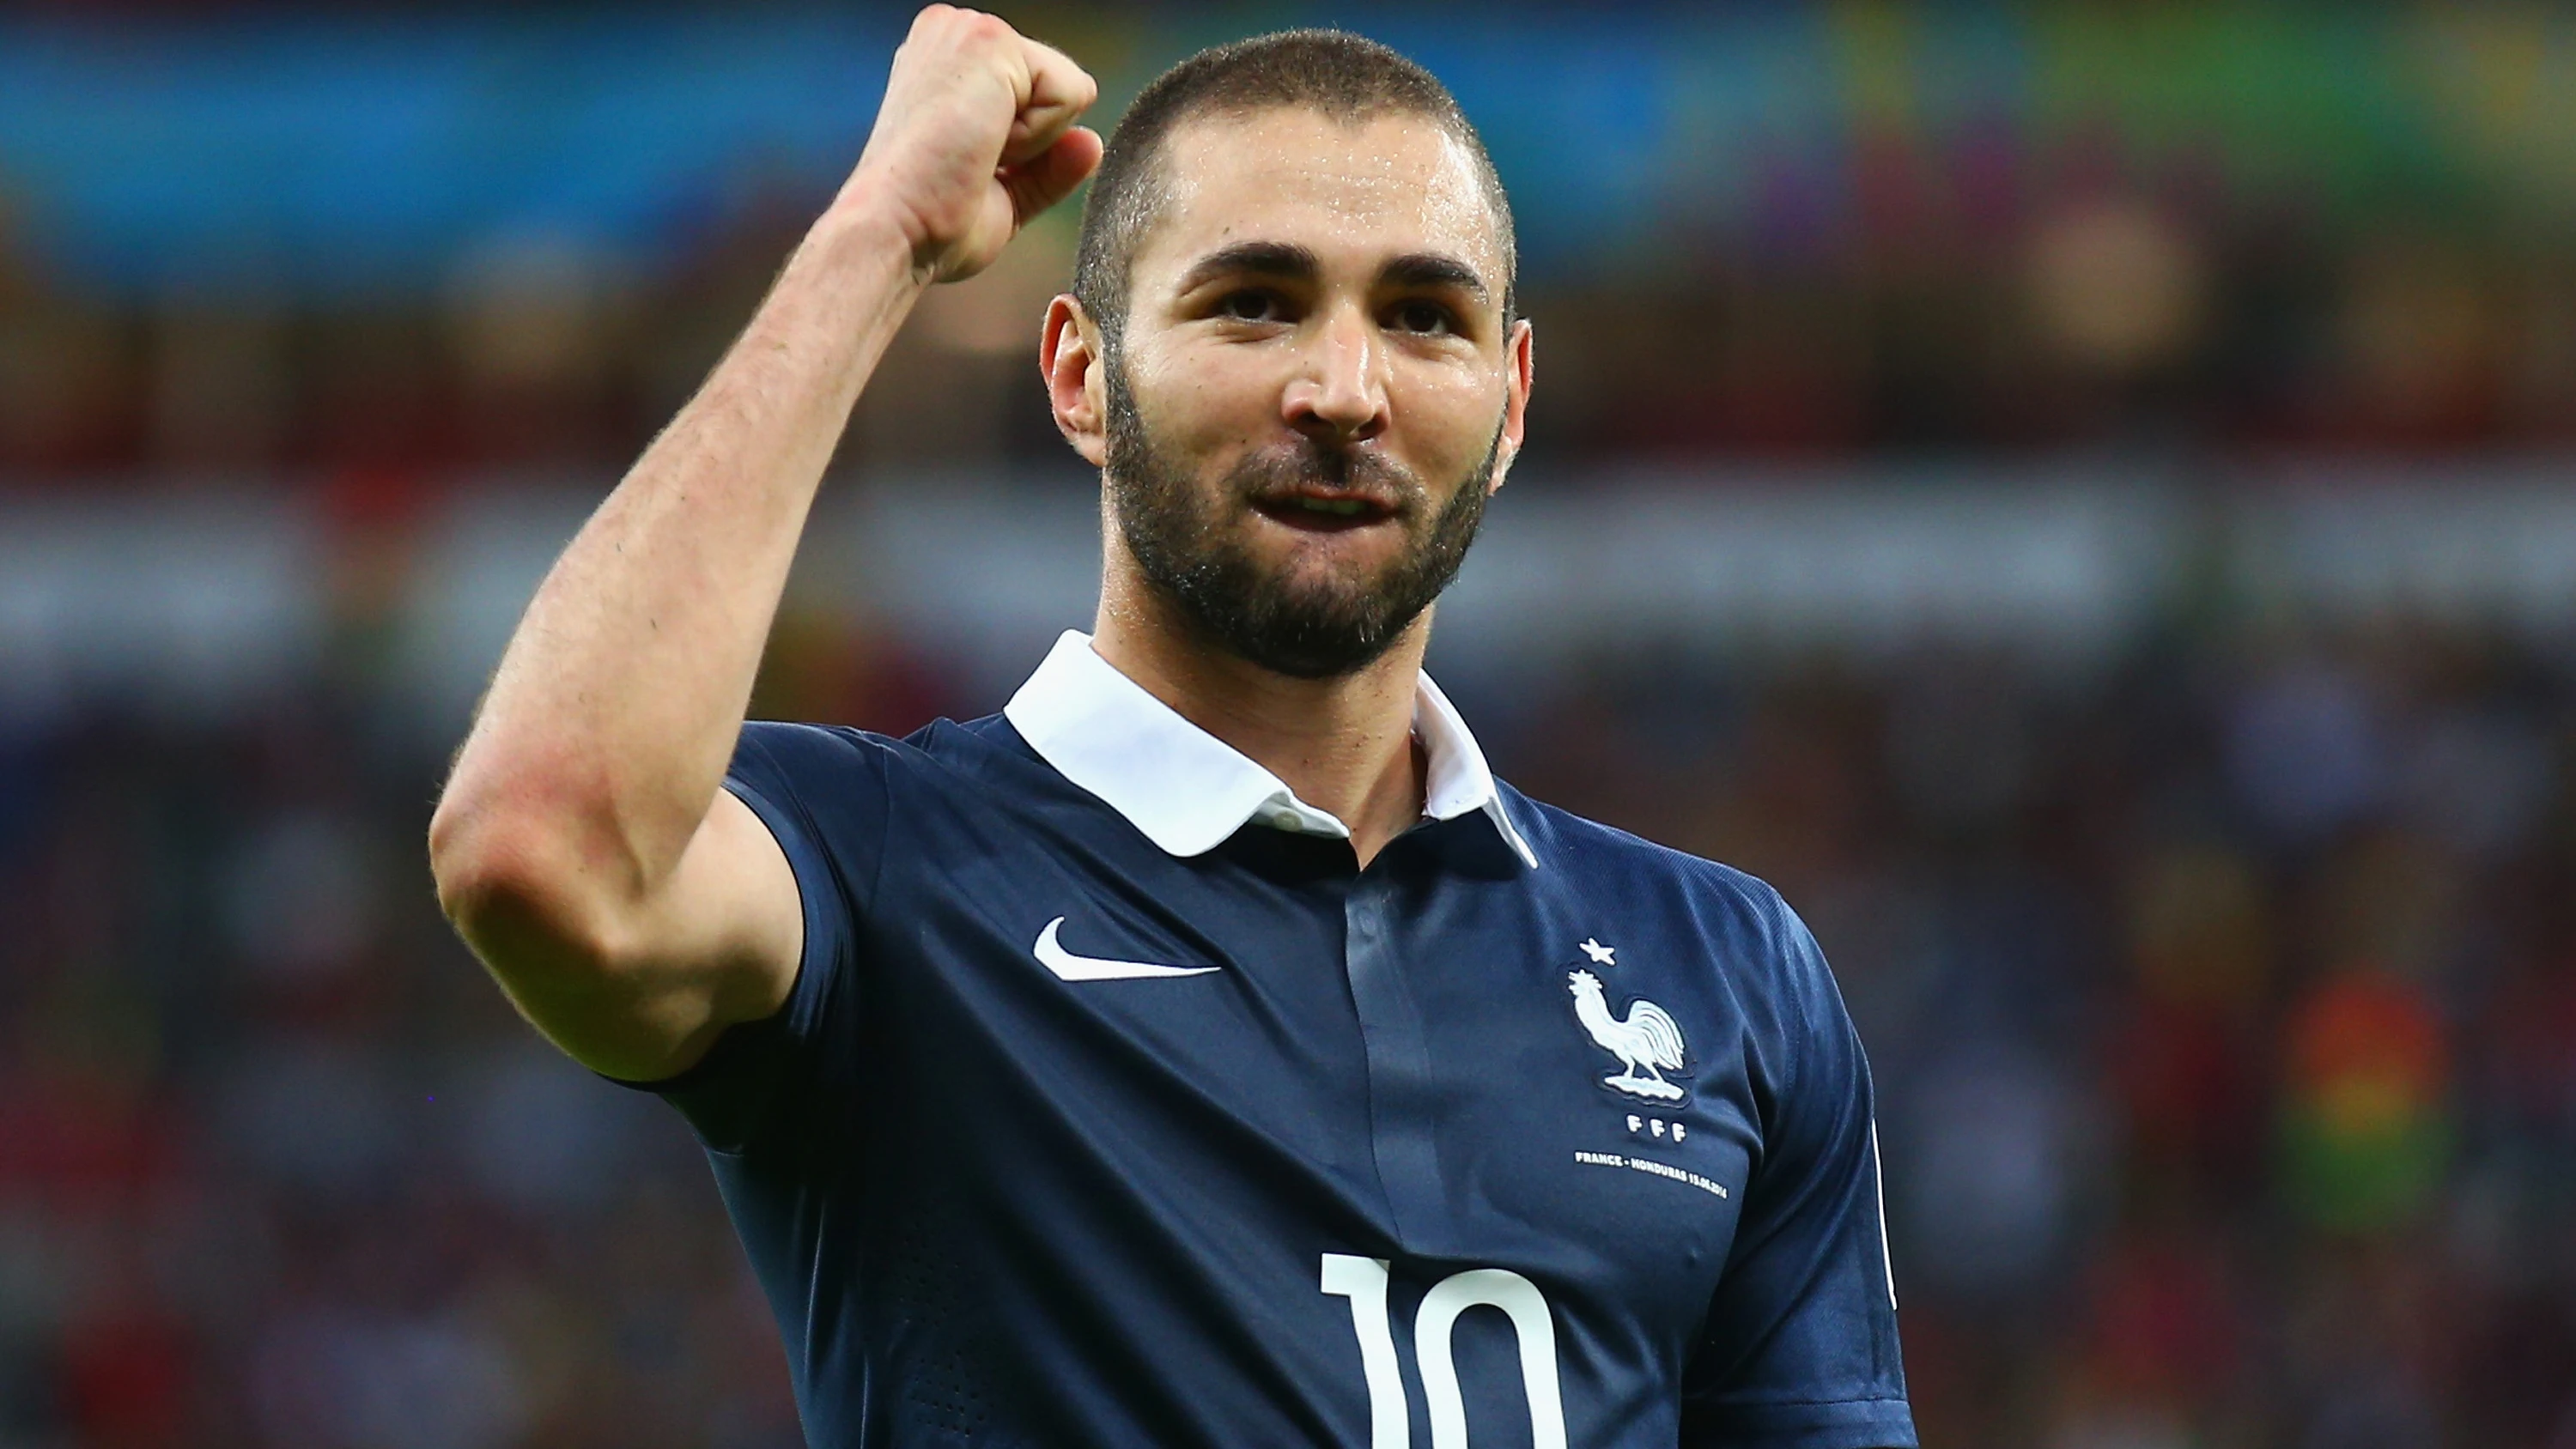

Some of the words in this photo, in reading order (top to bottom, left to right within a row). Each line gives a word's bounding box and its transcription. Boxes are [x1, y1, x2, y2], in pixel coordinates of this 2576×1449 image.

[1574, 1151, 1624, 1167] FRANCE
[1631, 1157, 1687, 1182] HONDURAS
[1321, 1252, 1569, 1449] 10
